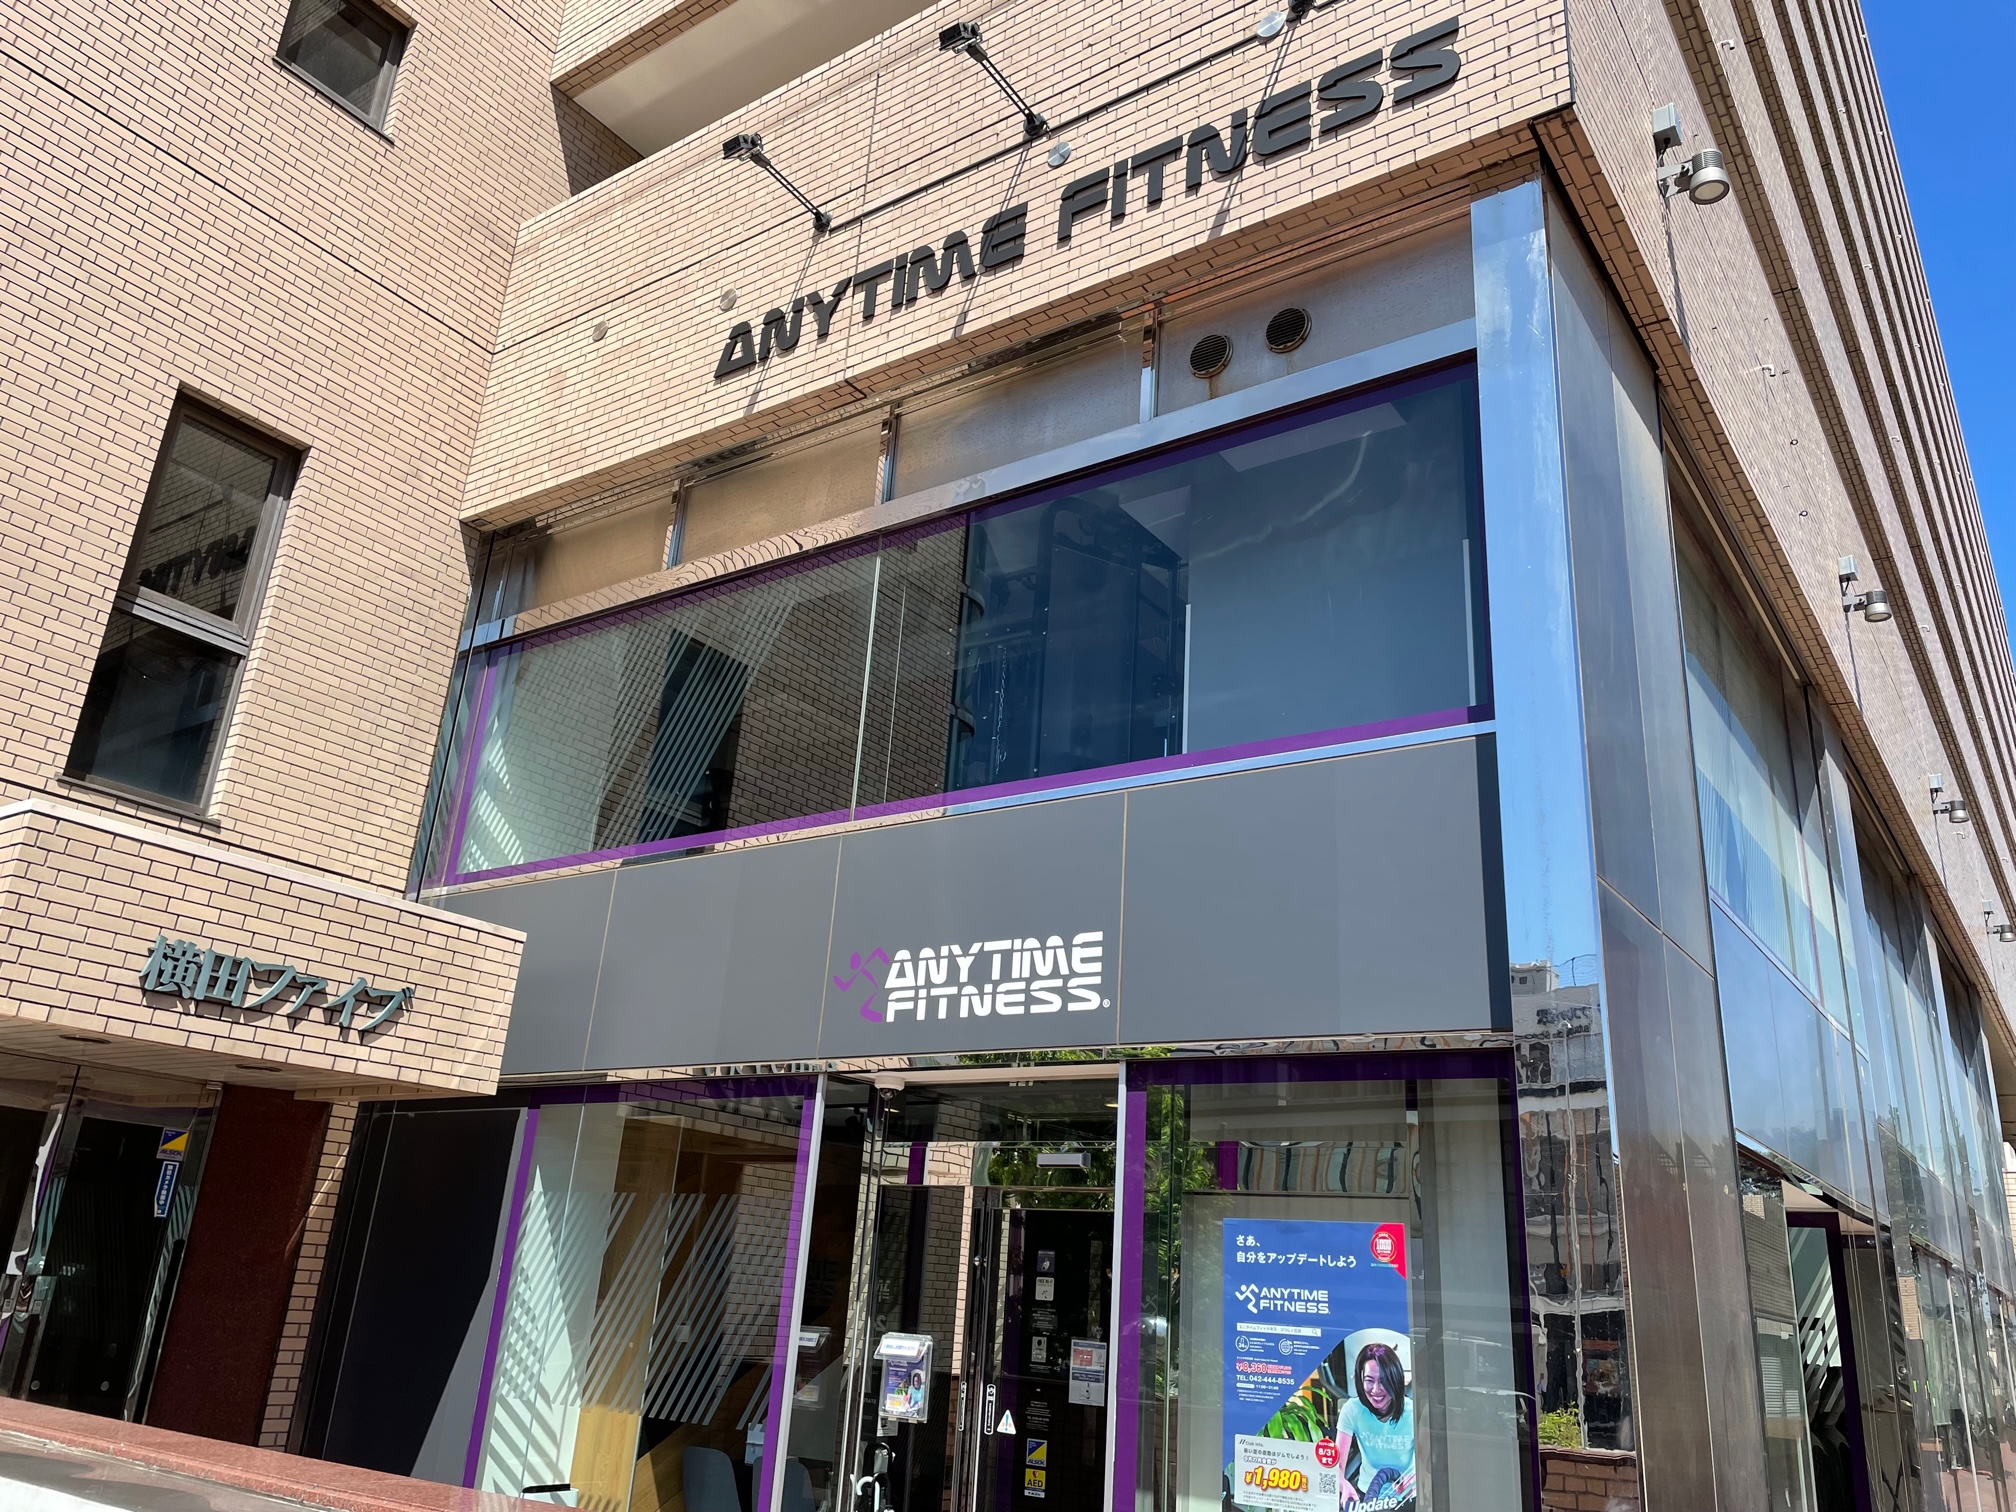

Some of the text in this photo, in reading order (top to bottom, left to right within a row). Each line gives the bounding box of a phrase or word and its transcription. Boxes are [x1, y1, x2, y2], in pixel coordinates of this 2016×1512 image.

[713, 17, 1461, 379] ANYTIME FITNESS
[884, 931, 1103, 989] ANYTIME
[139, 934, 415, 1031] 横田ファイブ
[1236, 1234, 1261, 1247] さあ、
[1236, 1250, 1357, 1268] 自分をアップデートしよう
[1259, 1287, 1329, 1302] ANYTIME
[1318, 1447, 1335, 1457] 8/31
[1321, 1457, 1333, 1465] まで
[1026, 1479, 1044, 1488] AED
